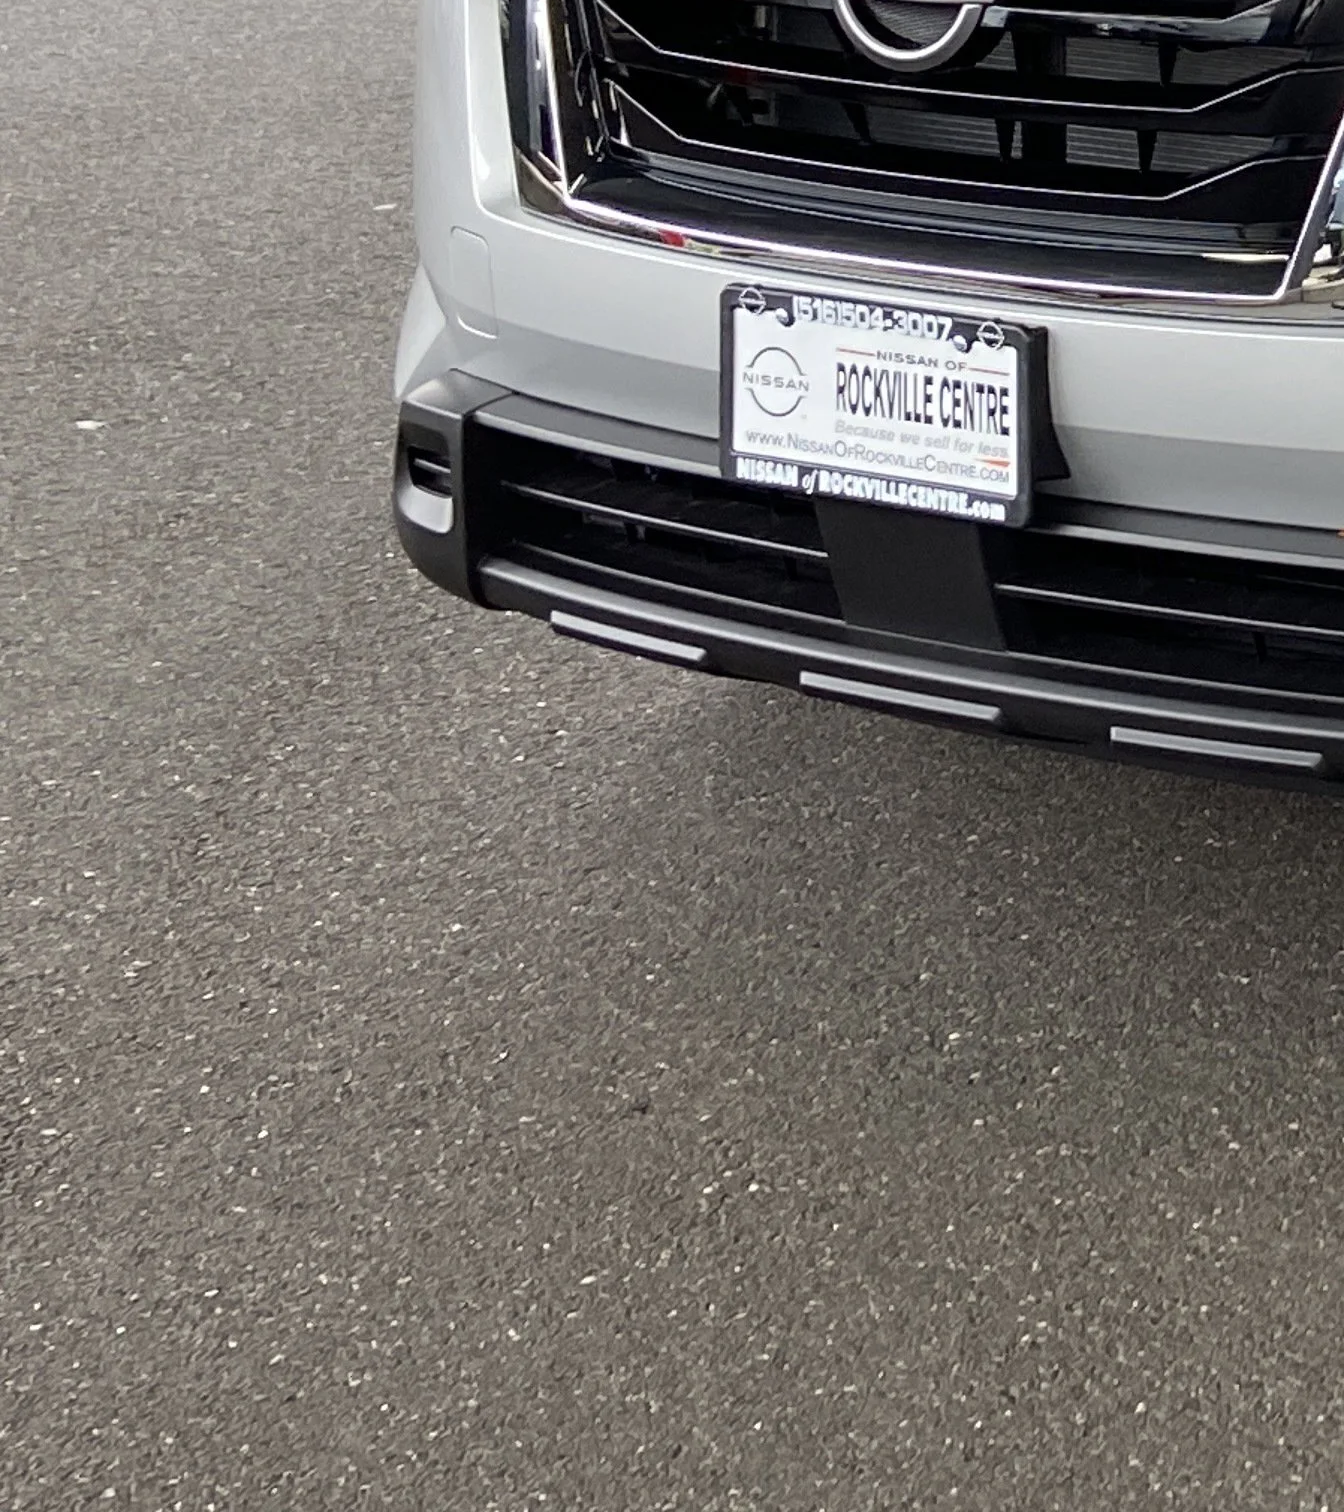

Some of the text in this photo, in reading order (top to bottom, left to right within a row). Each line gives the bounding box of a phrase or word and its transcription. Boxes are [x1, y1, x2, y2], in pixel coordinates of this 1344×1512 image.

[876, 350, 967, 370] NISSAN OF
[743, 371, 809, 392] NISSAN
[836, 362, 1010, 436] ROCKVILLE CENTRE
[736, 457, 799, 488] NISSAN
[801, 469, 819, 495] of
